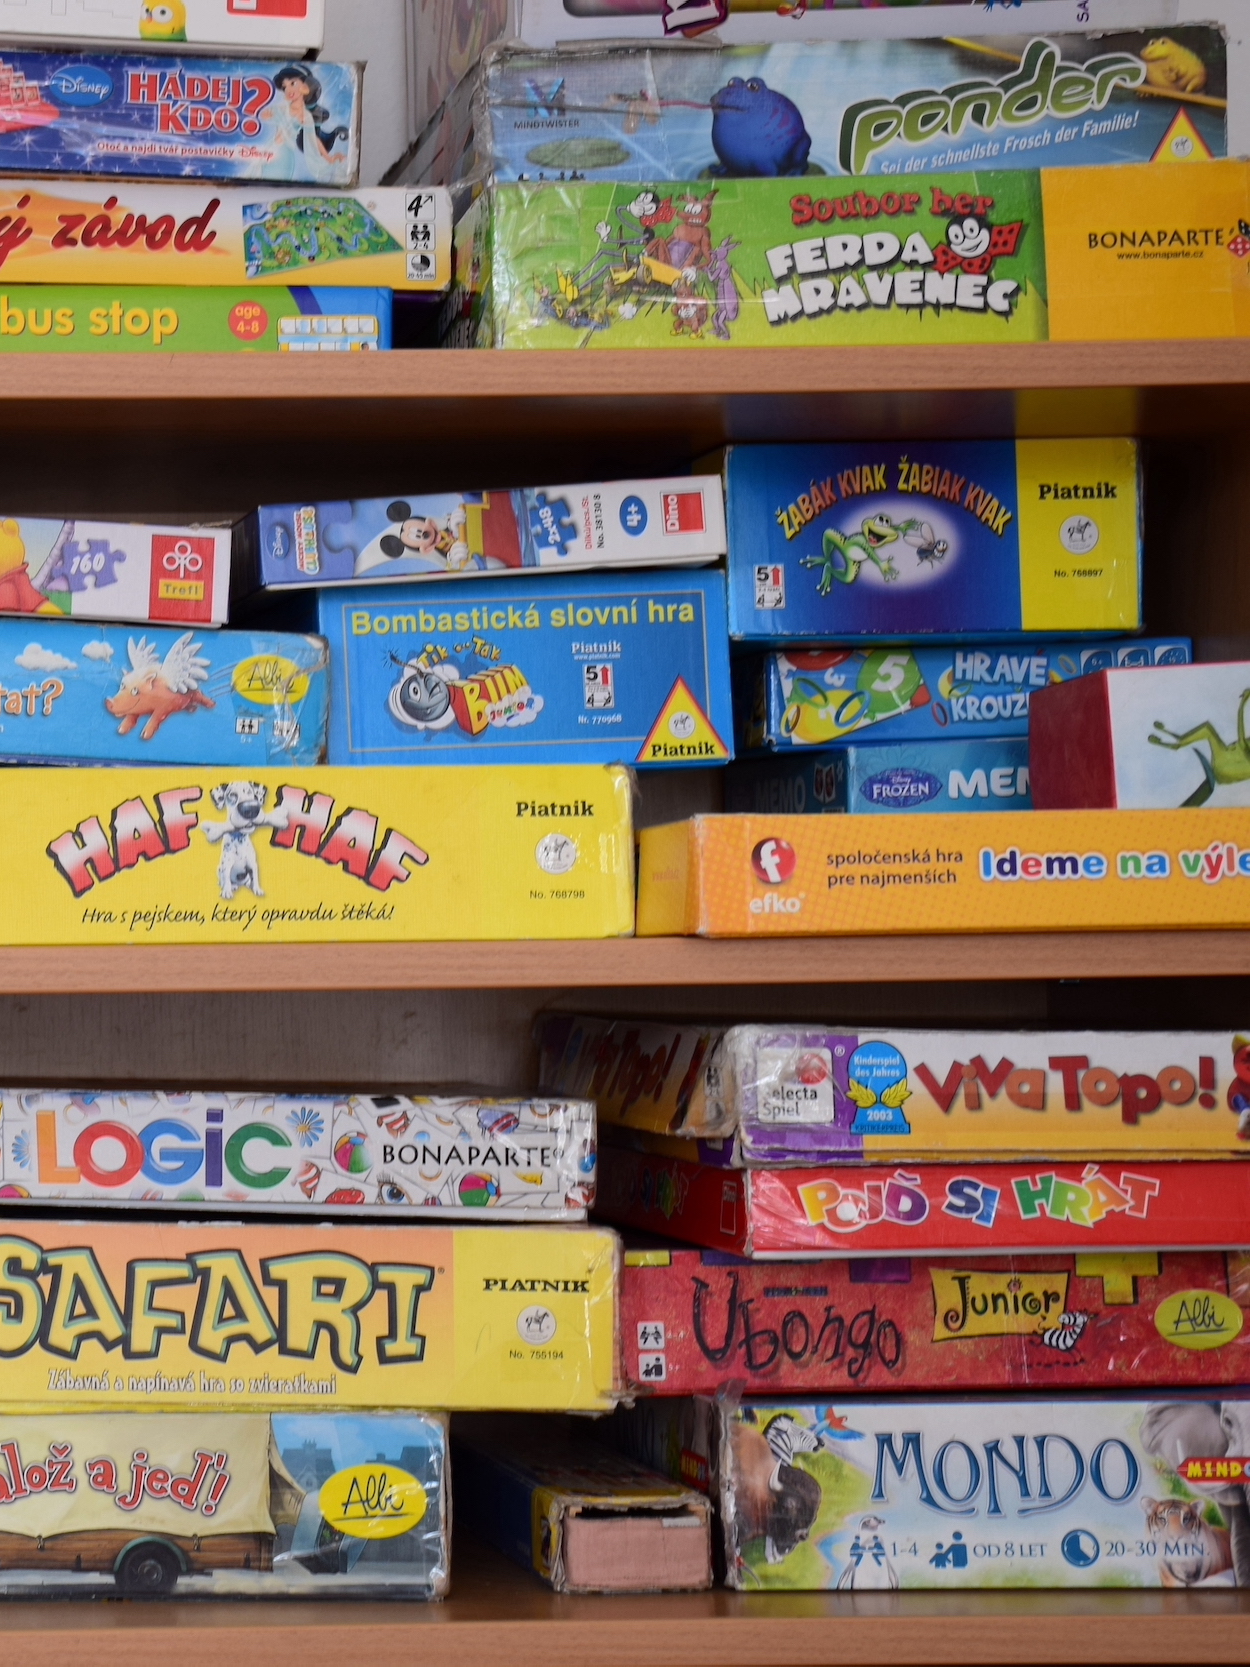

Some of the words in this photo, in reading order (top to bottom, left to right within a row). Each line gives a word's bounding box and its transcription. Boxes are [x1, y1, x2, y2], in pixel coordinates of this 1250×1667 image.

[840, 37, 1147, 175] ponder
[514, 119, 580, 129] MINDTWISTER
[905, 157, 928, 173] der
[930, 142, 1000, 167] schnellste
[1003, 131, 1052, 154] Frosch
[1055, 127, 1080, 144] der
[1082, 110, 1140, 138] Familie!
[407, 194, 423, 217] 4
[790, 189, 920, 227] Soubor
[930, 187, 994, 215] her
[51, 196, 221, 253] závod
[1088, 228, 1224, 249] BONAPARTE
[764, 231, 935, 286] FERDA
[1117, 250, 1204, 261] www.bonaparte.cz
[762, 270, 1021, 328] MRAVENEC
[0, 296, 75, 335] bus
[89, 301, 179, 346] stop
[235, 306, 261, 319] age
[236, 321, 261, 335] 4-8
[775, 481, 836, 541] ŽABÁK
[836, 463, 887, 505] KVAK
[897, 454, 963, 500] ŽABIAK
[963, 484, 1013, 537] KVAK
[1038, 482, 1118, 500] Piatnik
[627, 503, 641, 528] 4+
[665, 494, 679, 531] Dino
[69, 551, 105, 574] 160
[756, 567, 770, 583] 5
[164, 584, 200, 598] Trefl
[351, 604, 541, 636] Bombastická
[550, 599, 638, 627] slovní
[648, 599, 696, 623] hra
[571, 641, 622, 655] Piatnik
[868, 653, 910, 693] 5
[953, 649, 1048, 686] HRAVÉ
[651, 742, 716, 758] Piatnik
[872, 781, 930, 799] FROZEN
[515, 801, 594, 818] Piatnik
[46, 786, 203, 898] HAF
[270, 783, 430, 892] HAF
[826, 849, 928, 868] spoločenská
[931, 848, 964, 863] hra
[978, 847, 1108, 882] Ideme
[1116, 850, 1171, 880] na
[827, 873, 853, 890] pre
[858, 866, 957, 889] najmenších
[81, 907, 117, 925] Hra
[120, 911, 128, 924] s
[130, 906, 205, 932] pejskem,
[211, 904, 257, 932] který
[261, 900, 338, 930] opravdu
[341, 900, 395, 921] štěká!
[749, 894, 801, 914] efko
[854, 1055, 900, 1066] Kinderspiel
[855, 1067, 870, 1077] des
[871, 1067, 900, 1078] Jahres
[1048, 1055, 1217, 1125] Topo!
[763, 1102, 801, 1119] Spiel
[866, 1110, 894, 1122] 2003
[382, 1145, 552, 1168] BONAPARTE
[941, 1175, 1001, 1228] SI
[1011, 1163, 1161, 1228] HRÁT
[482, 1278, 590, 1293] PIATNIK
[943, 1275, 1061, 1333] Junior
[1172, 1295, 1226, 1332] Albi
[691, 1270, 901, 1379] Ubongo
[509, 1350, 525, 1359] No.
[529, 1350, 564, 1360] 755194
[47, 1367, 109, 1391] Zábavná
[114, 1378, 124, 1391] a
[128, 1370, 195, 1394] napínavá
[199, 1373, 226, 1393] hra
[230, 1378, 244, 1393] so
[247, 1374, 337, 1394] zvieratkami
[86, 1457, 118, 1493] a
[116, 1447, 230, 1516] jeď!
[871, 1432, 1140, 1518] MONDO
[342, 1473, 406, 1517] Albi
[892, 1541, 919, 1556] 1-4
[973, 1543, 1001, 1558] OD
[1004, 1542, 1015, 1558] 8
[1020, 1543, 1048, 1558] LET
